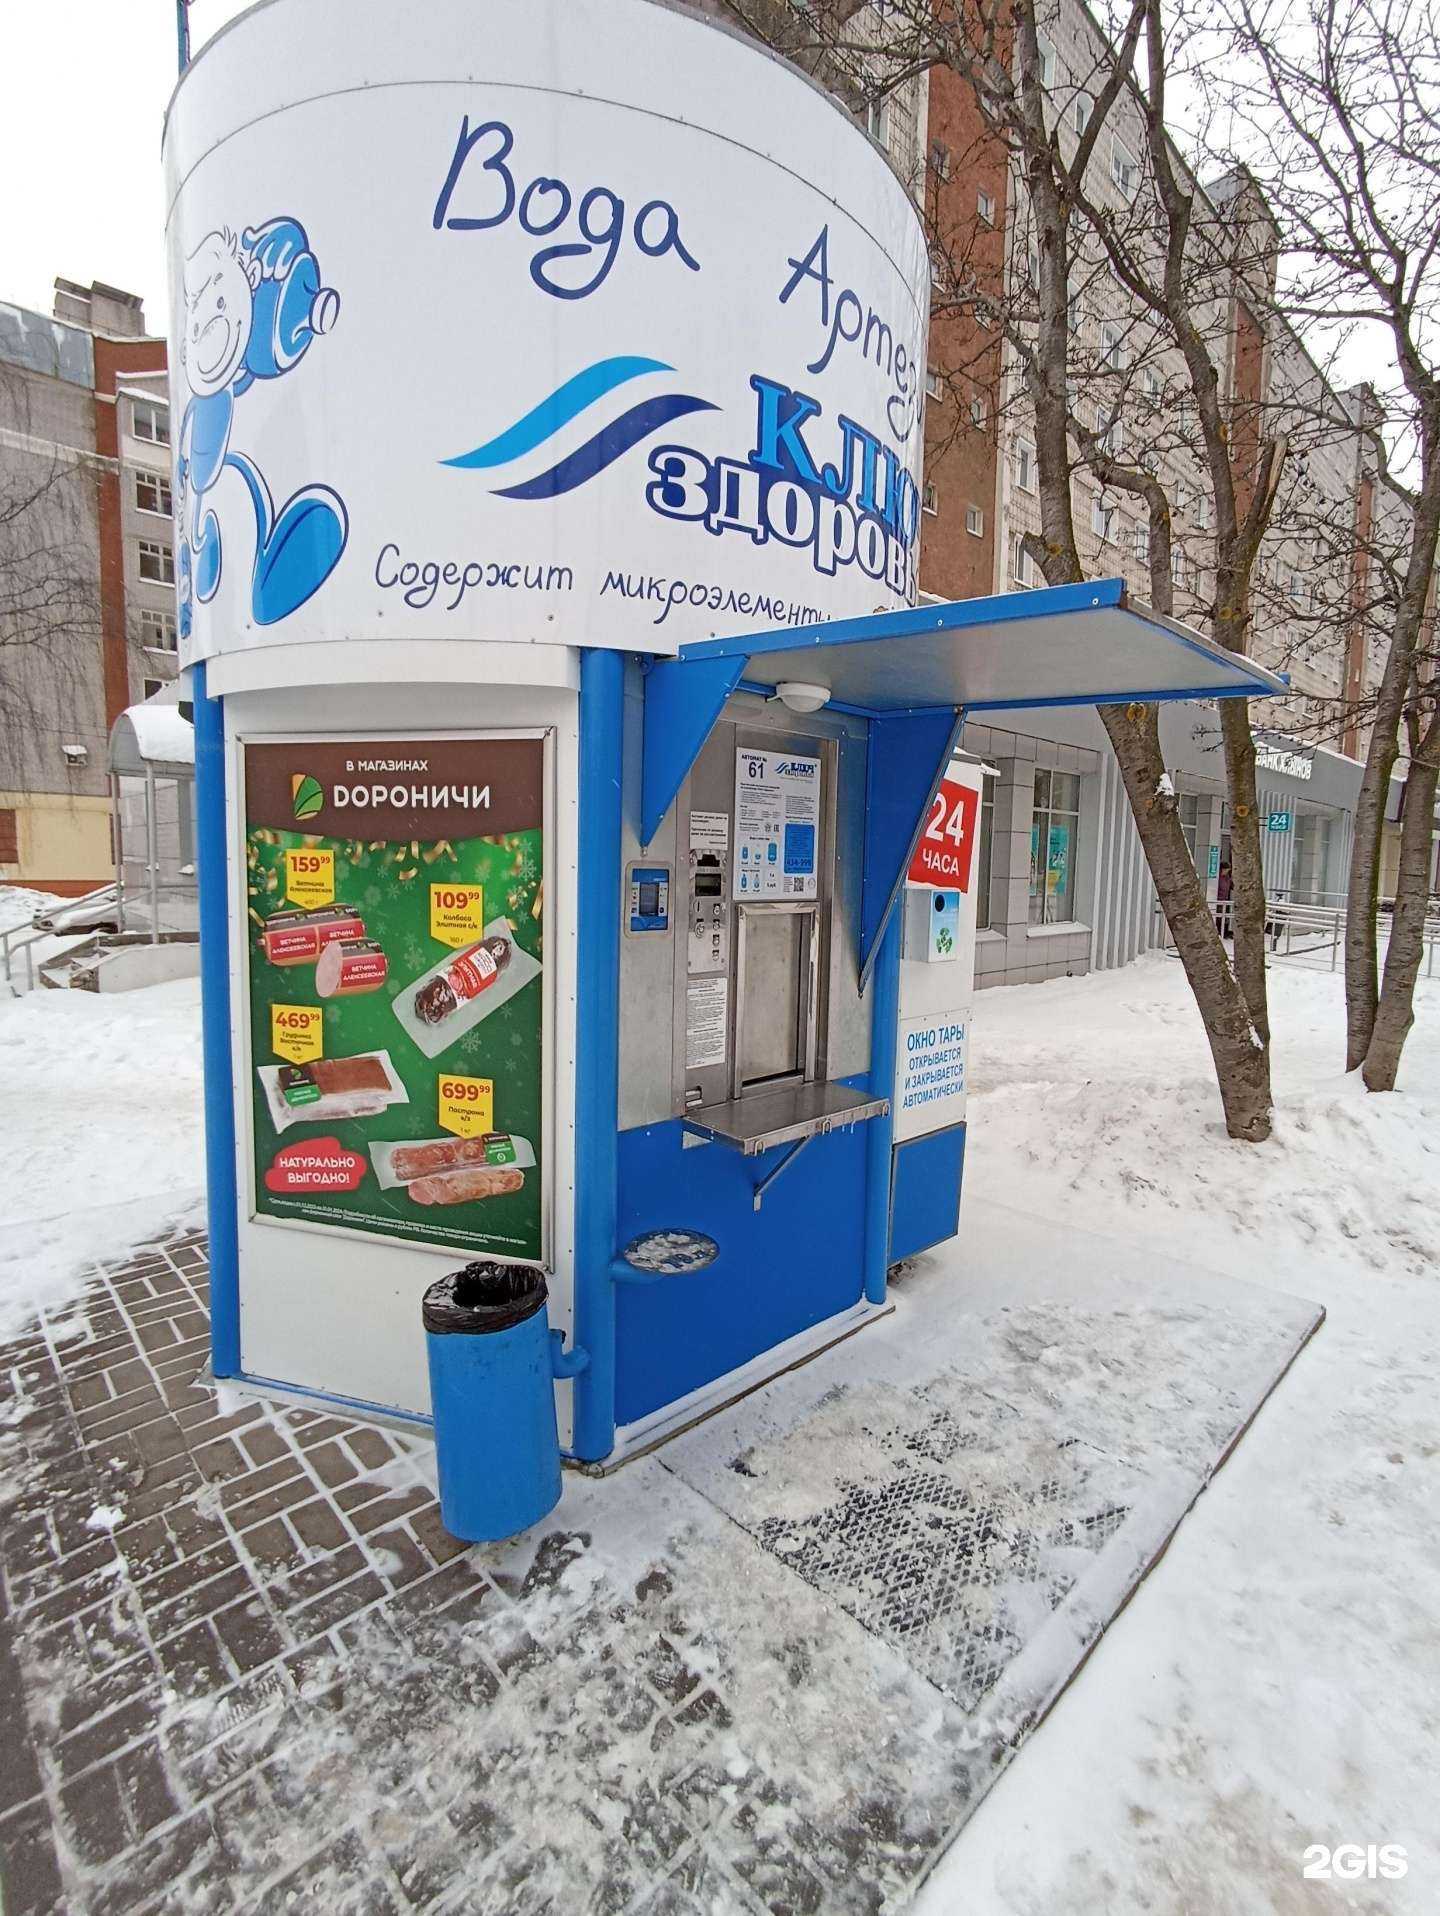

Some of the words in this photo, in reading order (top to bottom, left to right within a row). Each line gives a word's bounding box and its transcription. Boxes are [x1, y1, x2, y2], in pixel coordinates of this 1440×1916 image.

[433, 113, 700, 300] Вода
[375, 543, 573, 610] Содержит
[346, 760, 356, 771] В
[358, 760, 429, 772] МАГАЗИНАХ
[748, 761, 764, 779] 61
[925, 792, 964, 847] 24
[1271, 814, 1287, 825] 24
[922, 847, 960, 877] ЧАСА
[907, 1029, 936, 1052] ОКНО
[938, 1023, 965, 1044] ТАРЫ
[909, 1046, 961, 1071] ОТКРЫВАЕТСЯ
[911, 1063, 963, 1088] ЗАКРЫВАЕТСЯ
[903, 1079, 963, 1109] АВТОМАТИЧЕСКИ
[279, 1156, 355, 1168] НАТУРАЛЬНО
[287, 1171, 350, 1185] ВЫГОДНО!
